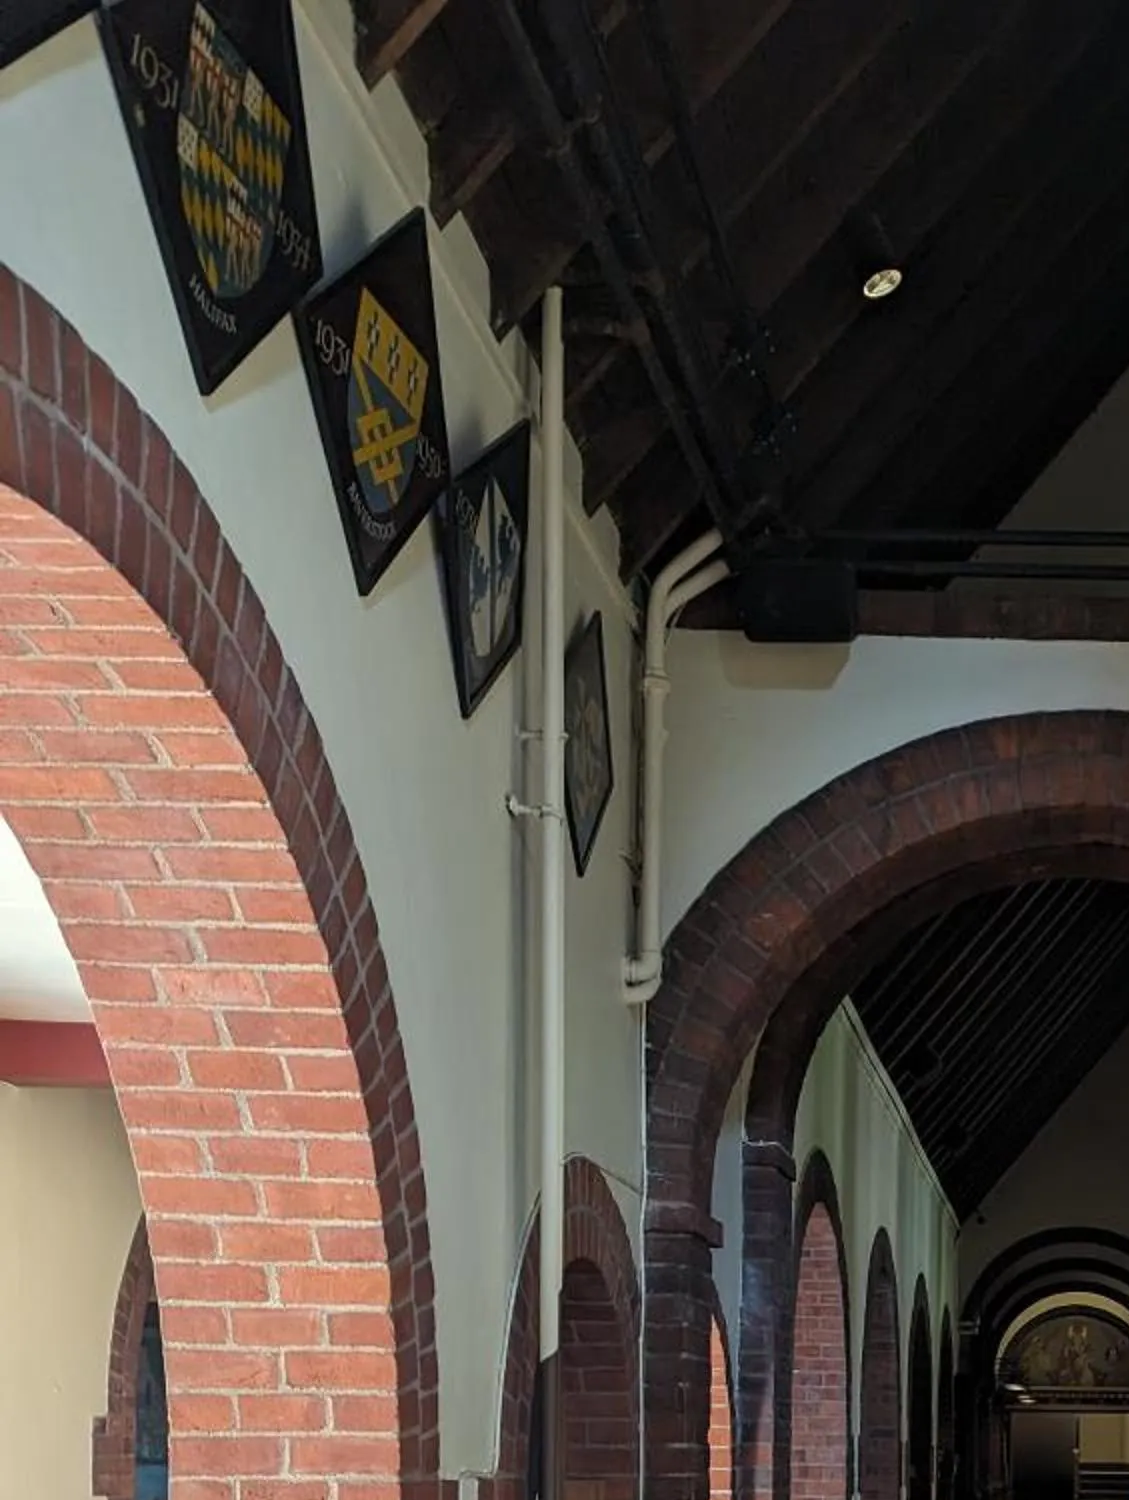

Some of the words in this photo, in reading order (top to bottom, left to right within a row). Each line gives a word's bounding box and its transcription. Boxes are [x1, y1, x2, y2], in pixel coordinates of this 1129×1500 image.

[129, 33, 179, 109] 1931
[189, 272, 238, 334] HALIFAX
[315, 318, 351, 378] 1931
